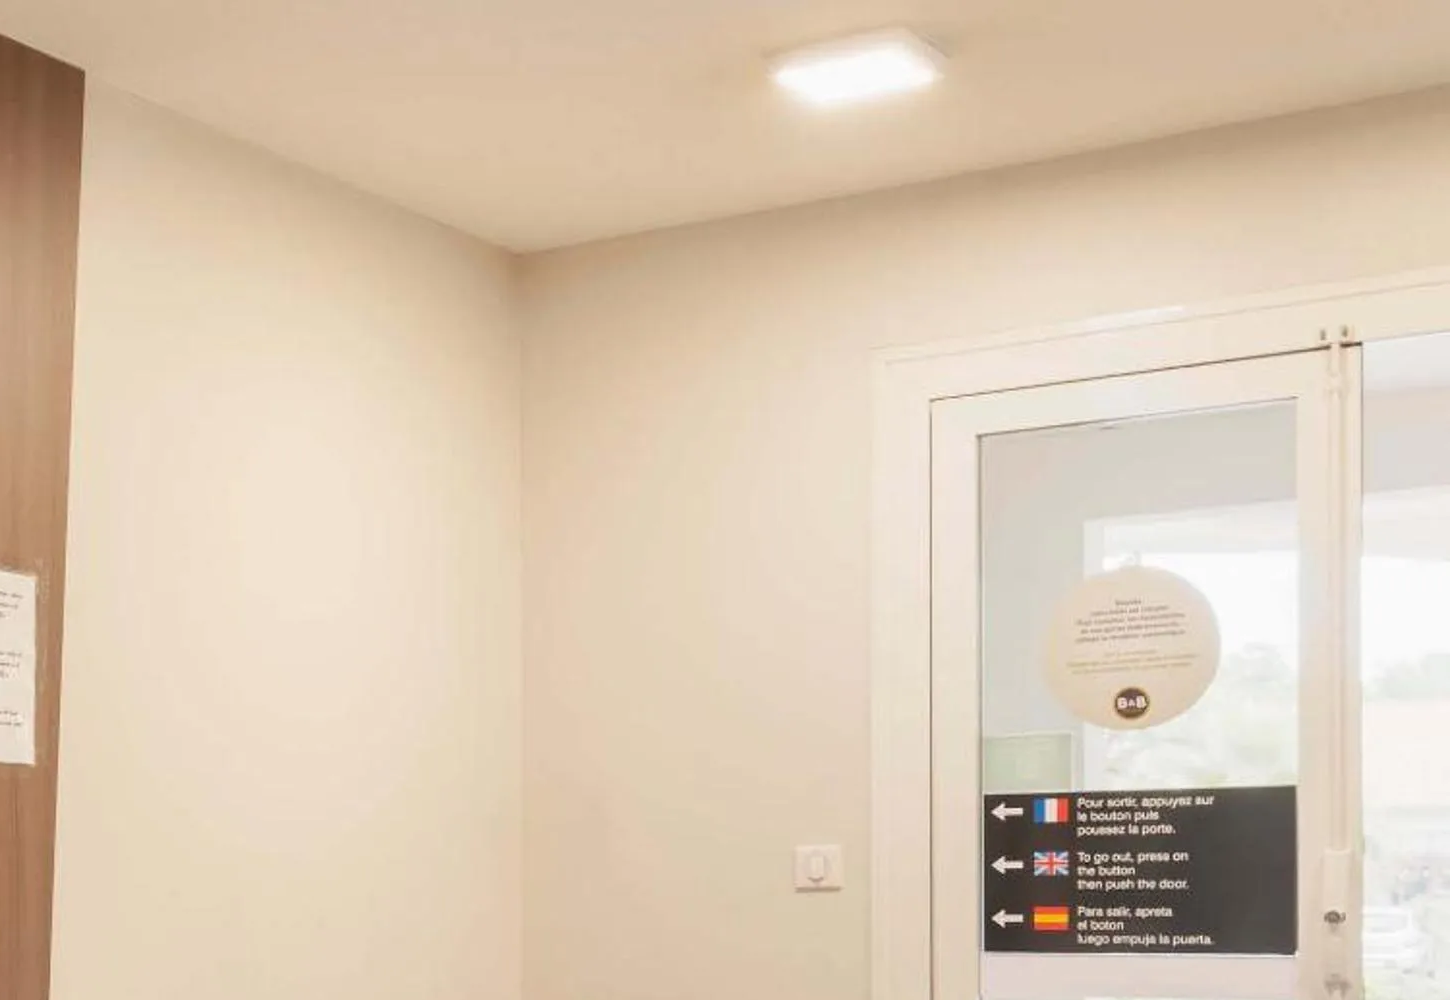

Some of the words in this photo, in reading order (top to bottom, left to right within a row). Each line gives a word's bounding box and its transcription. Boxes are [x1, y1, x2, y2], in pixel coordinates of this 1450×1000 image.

[1077, 796, 1104, 809] Pour
[1141, 796, 1192, 809] appuyez
[1195, 795, 1215, 806] sur
[1076, 810, 1087, 822] le
[1090, 810, 1131, 821] bouton
[1134, 810, 1159, 823] puis
[1077, 824, 1126, 837] poussez
[1128, 823, 1139, 834] la
[1142, 824, 1177, 836] porte.
[1077, 851, 1091, 862] To
[1093, 852, 1109, 865] go
[1112, 851, 1134, 863] out,
[1137, 851, 1170, 864] press
[1172, 851, 1189, 862] on
[1076, 865, 1095, 876] the
[1097, 865, 1136, 876] button
[1076, 879, 1103, 890] then
[1105, 879, 1135, 893] push
[1137, 879, 1157, 890] the
[1159, 878, 1190, 890] door.
[1077, 906, 1104, 917] Para
[1135, 906, 1173, 919] apreta
[1076, 920, 1088, 931] el
[1090, 919, 1124, 931] boton
[1077, 933, 1110, 947] luego
[1112, 933, 1156, 947] empuja
[1159, 933, 1171, 944] la
[1172, 934, 1216, 947] puerta.
